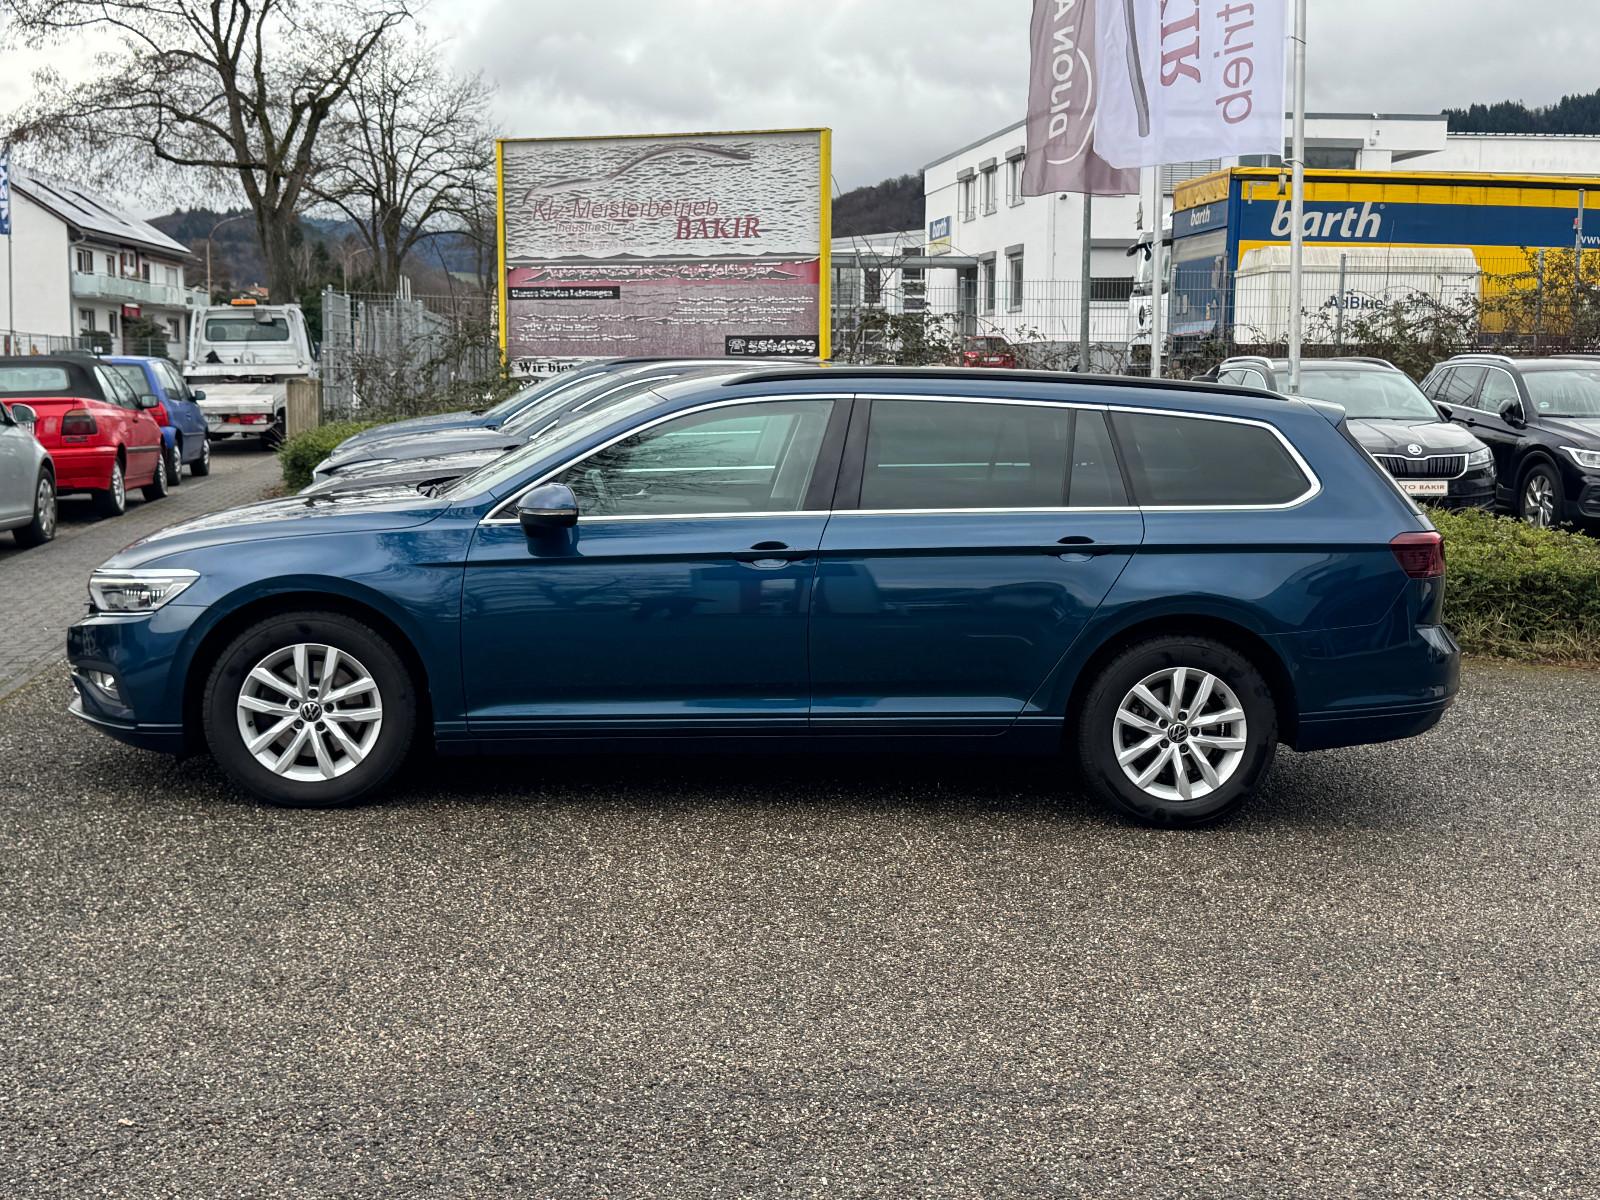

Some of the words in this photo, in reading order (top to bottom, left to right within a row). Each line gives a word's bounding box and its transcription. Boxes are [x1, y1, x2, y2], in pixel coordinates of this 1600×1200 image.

[1190, 205, 1211, 226] barth
[1270, 199, 1382, 238] barth
[674, 216, 761, 240] BAKIR
[518, 362, 544, 373] Wir
